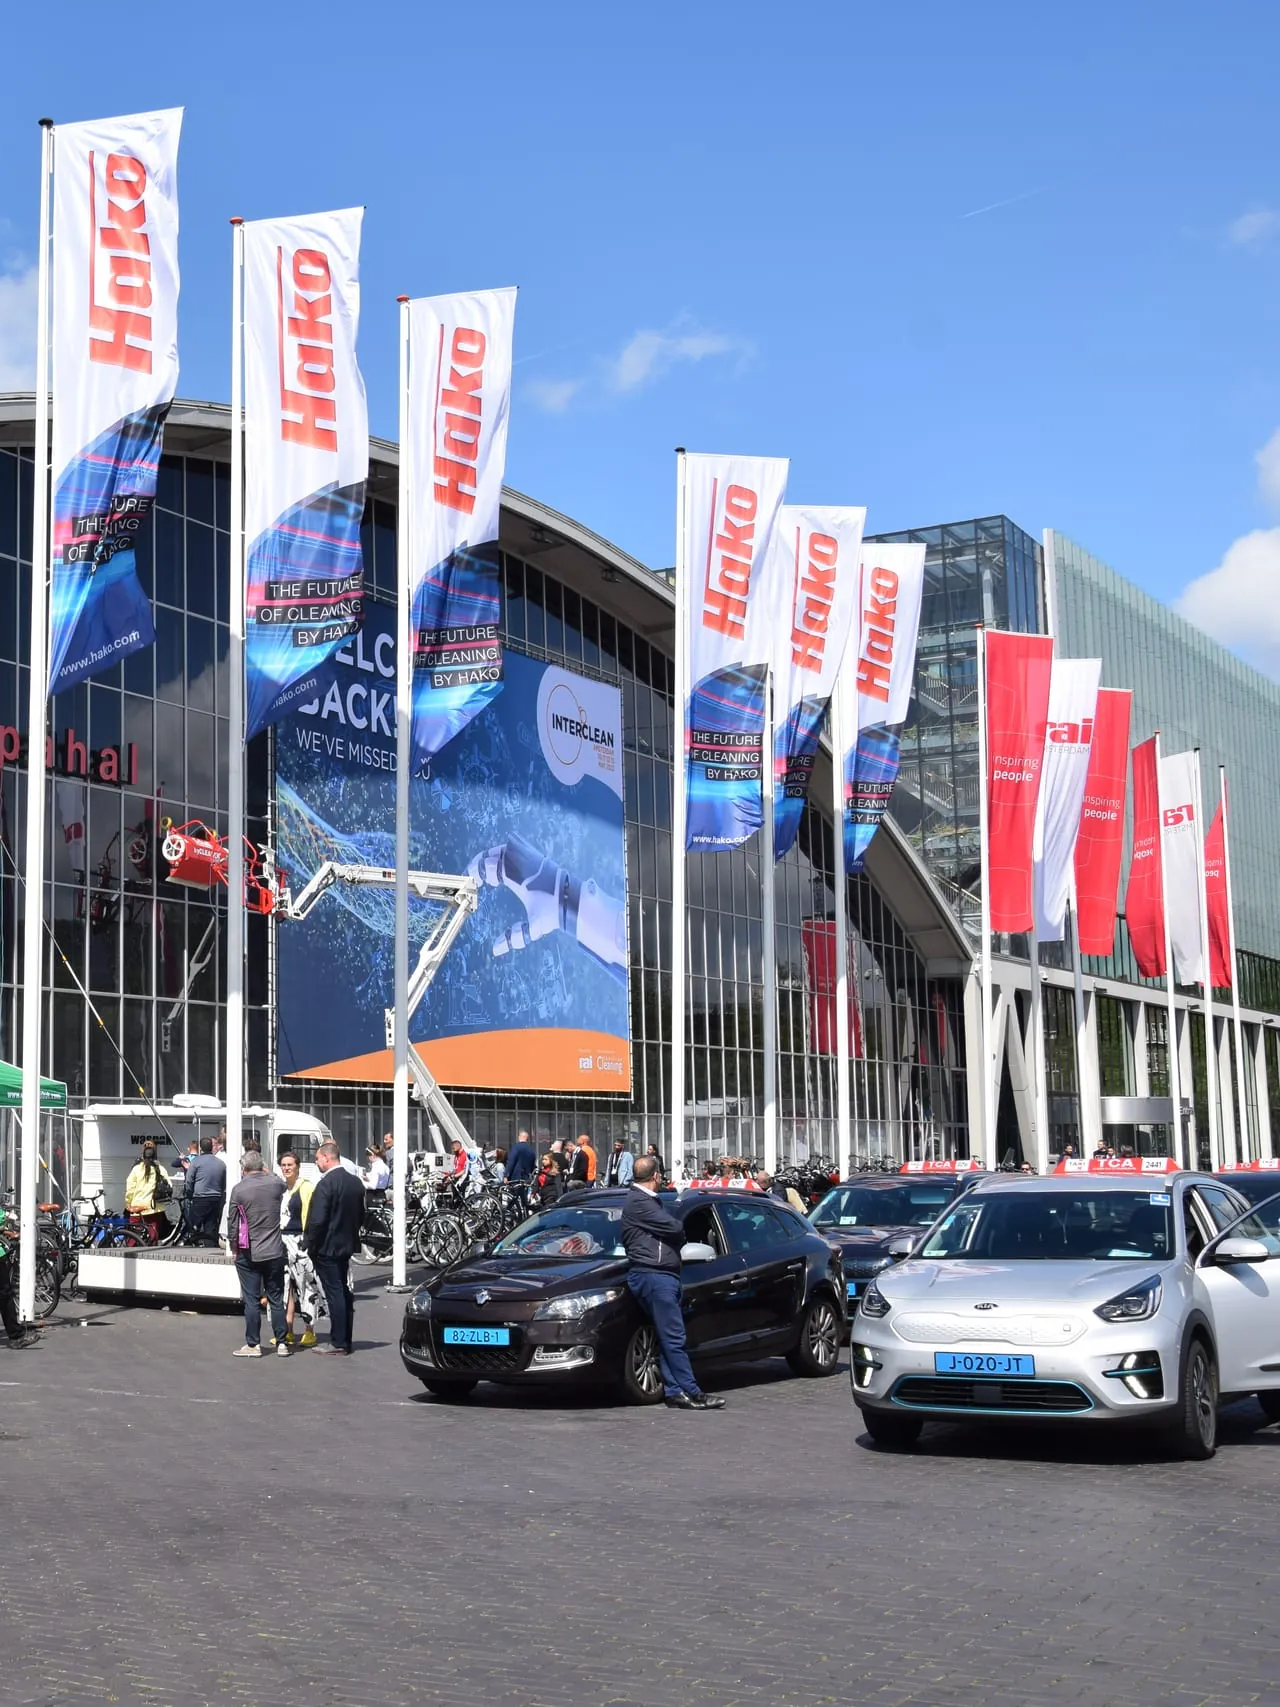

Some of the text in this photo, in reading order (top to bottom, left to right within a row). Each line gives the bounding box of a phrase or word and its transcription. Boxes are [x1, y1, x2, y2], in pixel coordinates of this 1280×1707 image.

[88, 150, 153, 375] Hako
[277, 245, 338, 453] Hako
[433, 323, 487, 516] Hako
[68, 544, 89, 561] OF
[702, 478, 758, 642] Hako
[269, 584, 301, 598] THE
[790, 526, 839, 675] Hako
[260, 608, 283, 622] OF
[298, 631, 321, 645] BY
[420, 626, 497, 644] THE FUTURE
[856, 563, 899, 704] Hako
[59, 628, 141, 678] www.hako.com
[427, 647, 498, 665] CLEANING
[434, 667, 500, 687] BY HAKO
[552, 712, 614, 749] INTERCLEAN
[692, 731, 761, 746] THE FUTURE
[295, 727, 345, 760] WE'VE
[348, 740, 398, 773] MISSED
[702, 750, 760, 763] CLEANING
[707, 768, 758, 780] BY HAKO
[993, 770, 1034, 784] people
[858, 783, 895, 794] FUTURE
[849, 798, 888, 808] CLEANIN
[1084, 808, 1117, 822] people
[929, 1160, 952, 1168] TCA
[1097, 1159, 1134, 1168] TCA
[1145, 1161, 1163, 1169] 2441
[698, 1179, 722, 1188] TCA
[452, 1330, 499, 1343] 82-ZLB-1
[949, 1355, 1023, 1372] J-020-JT
